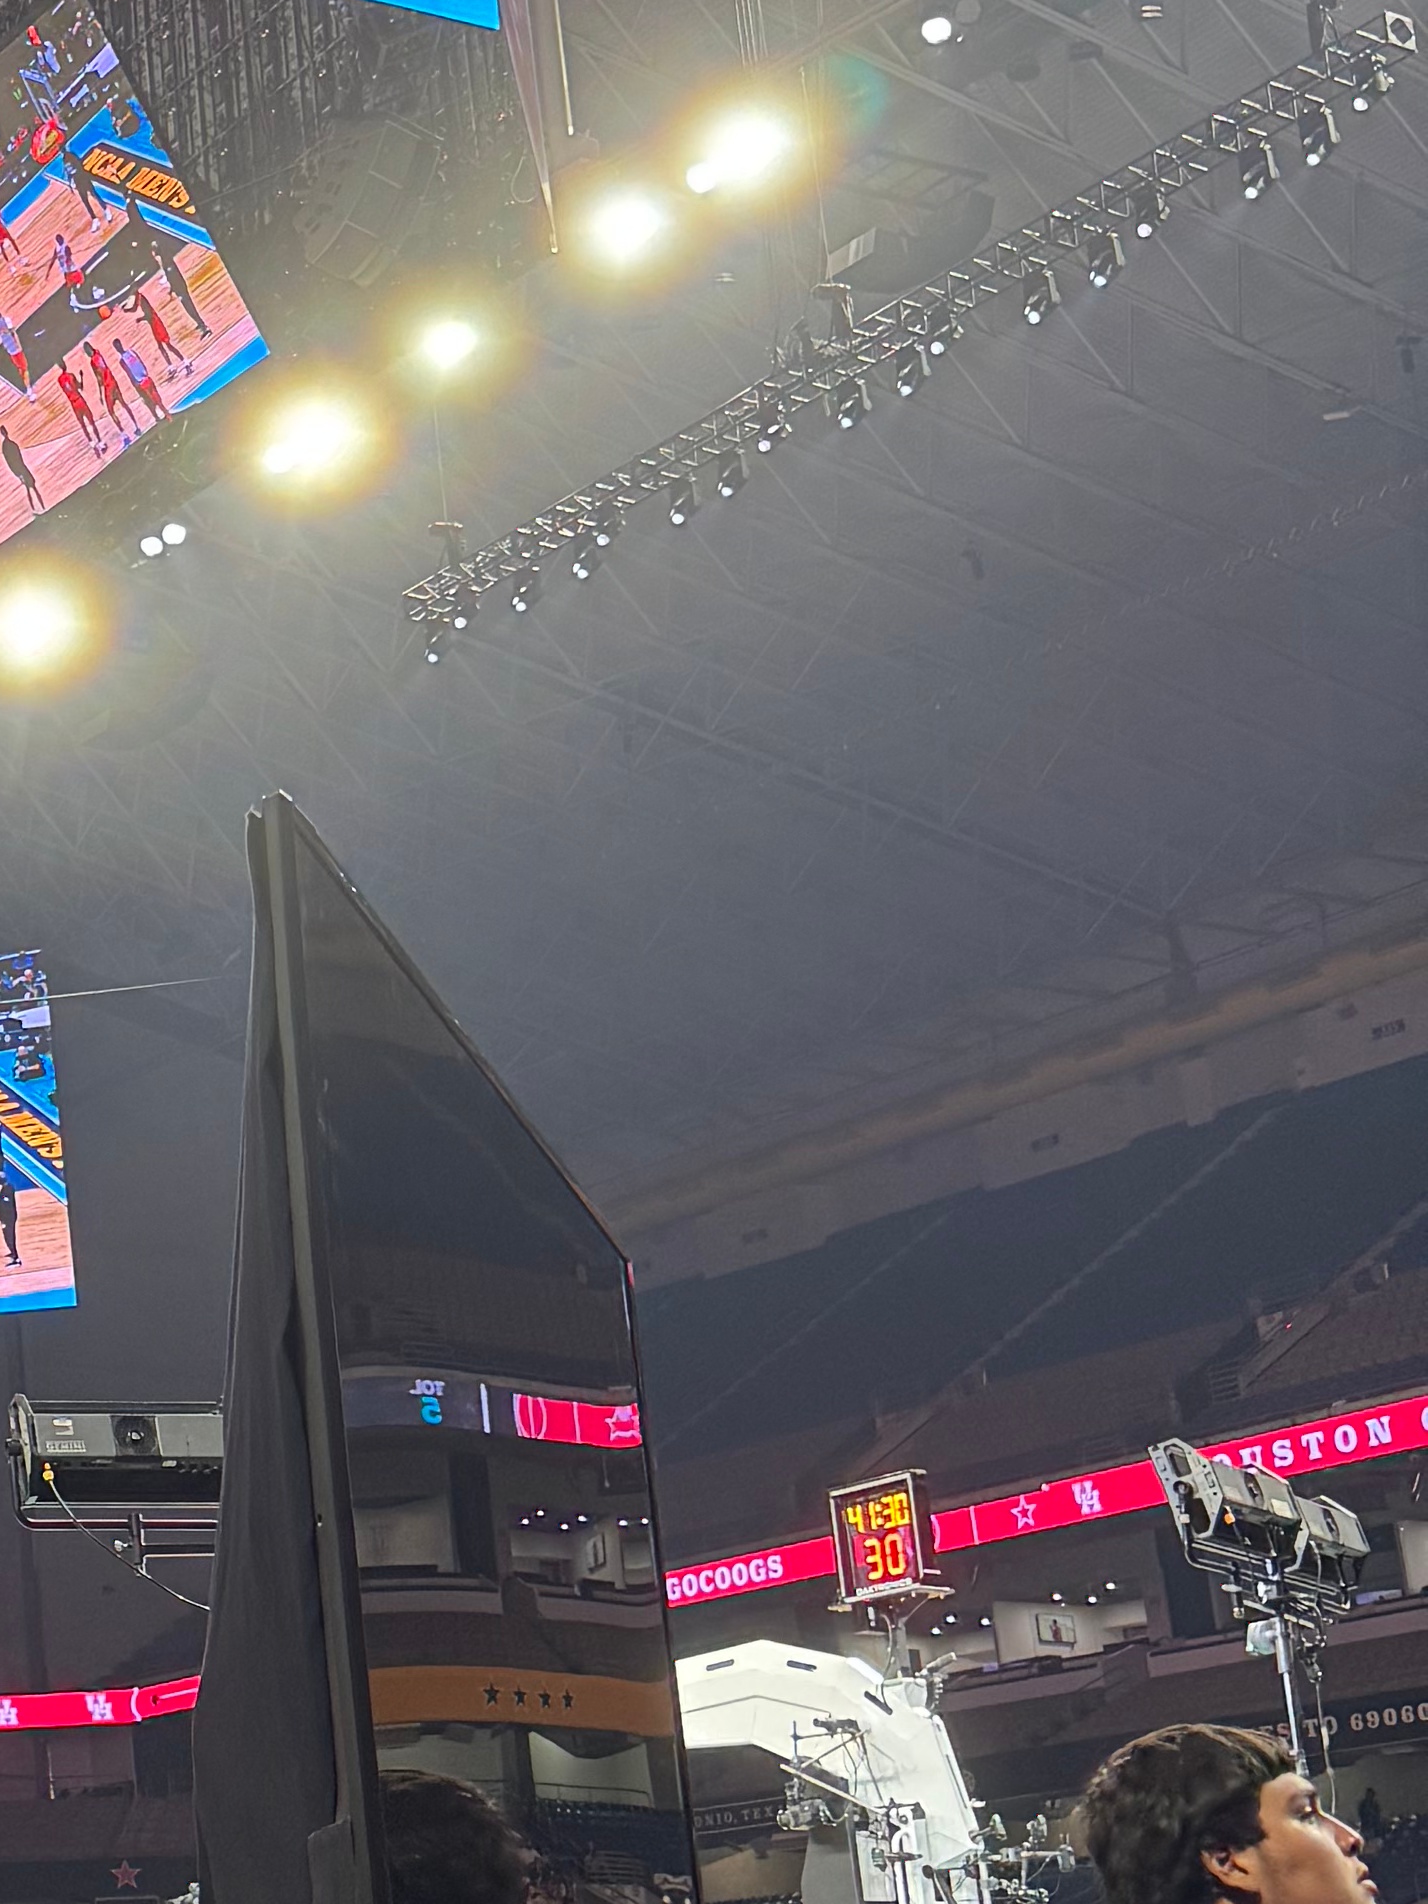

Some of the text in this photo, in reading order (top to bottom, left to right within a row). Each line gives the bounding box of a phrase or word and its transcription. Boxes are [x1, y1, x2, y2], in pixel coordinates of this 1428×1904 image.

[847, 1492, 911, 1533] 41:30
[864, 1533, 907, 1580] 30
[666, 1554, 784, 1601] GOCOOGS
[1302, 1716, 1338, 1738] TO
[741, 1805, 776, 1822] TEX
